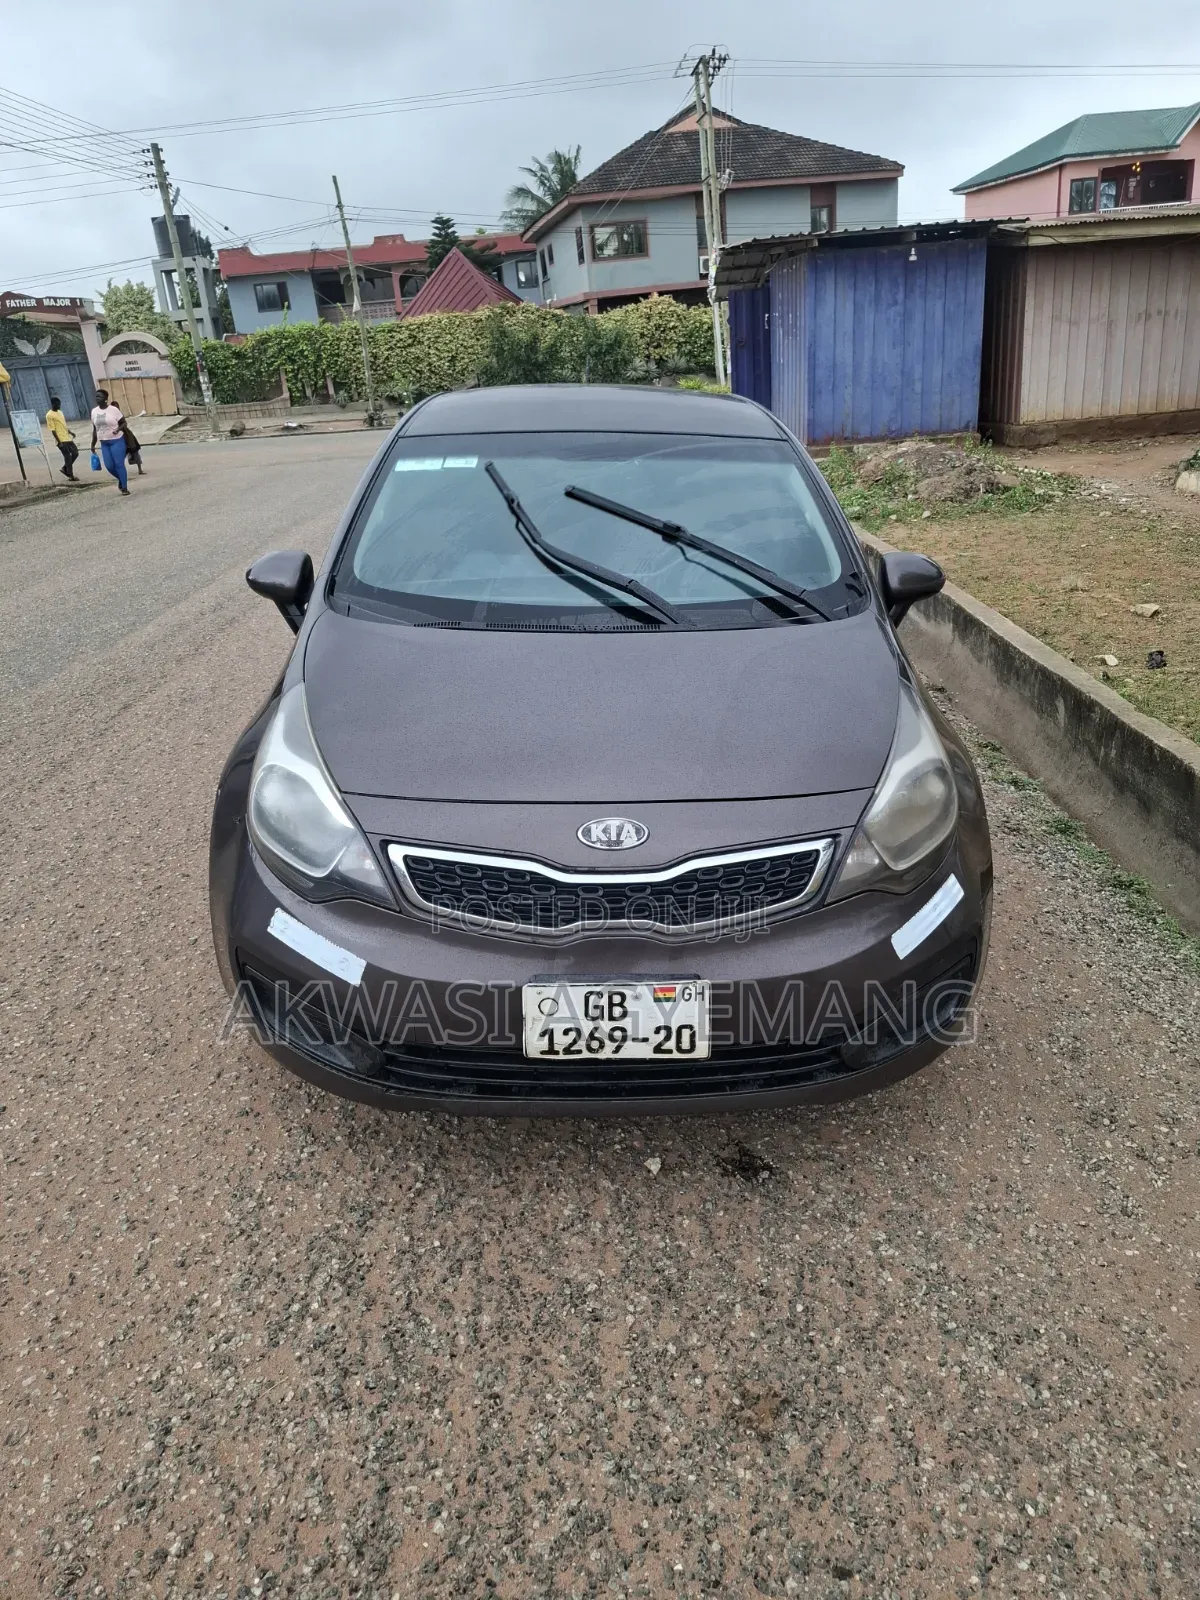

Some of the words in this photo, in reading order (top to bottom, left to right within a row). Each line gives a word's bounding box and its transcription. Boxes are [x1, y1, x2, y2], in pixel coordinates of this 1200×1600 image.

[6, 299, 37, 308] FATHER
[43, 298, 71, 307] MAJOR
[590, 822, 638, 841] KIA
[681, 986, 705, 1002] GH
[584, 990, 628, 1022] GB
[539, 1024, 697, 1055] 1269-20
